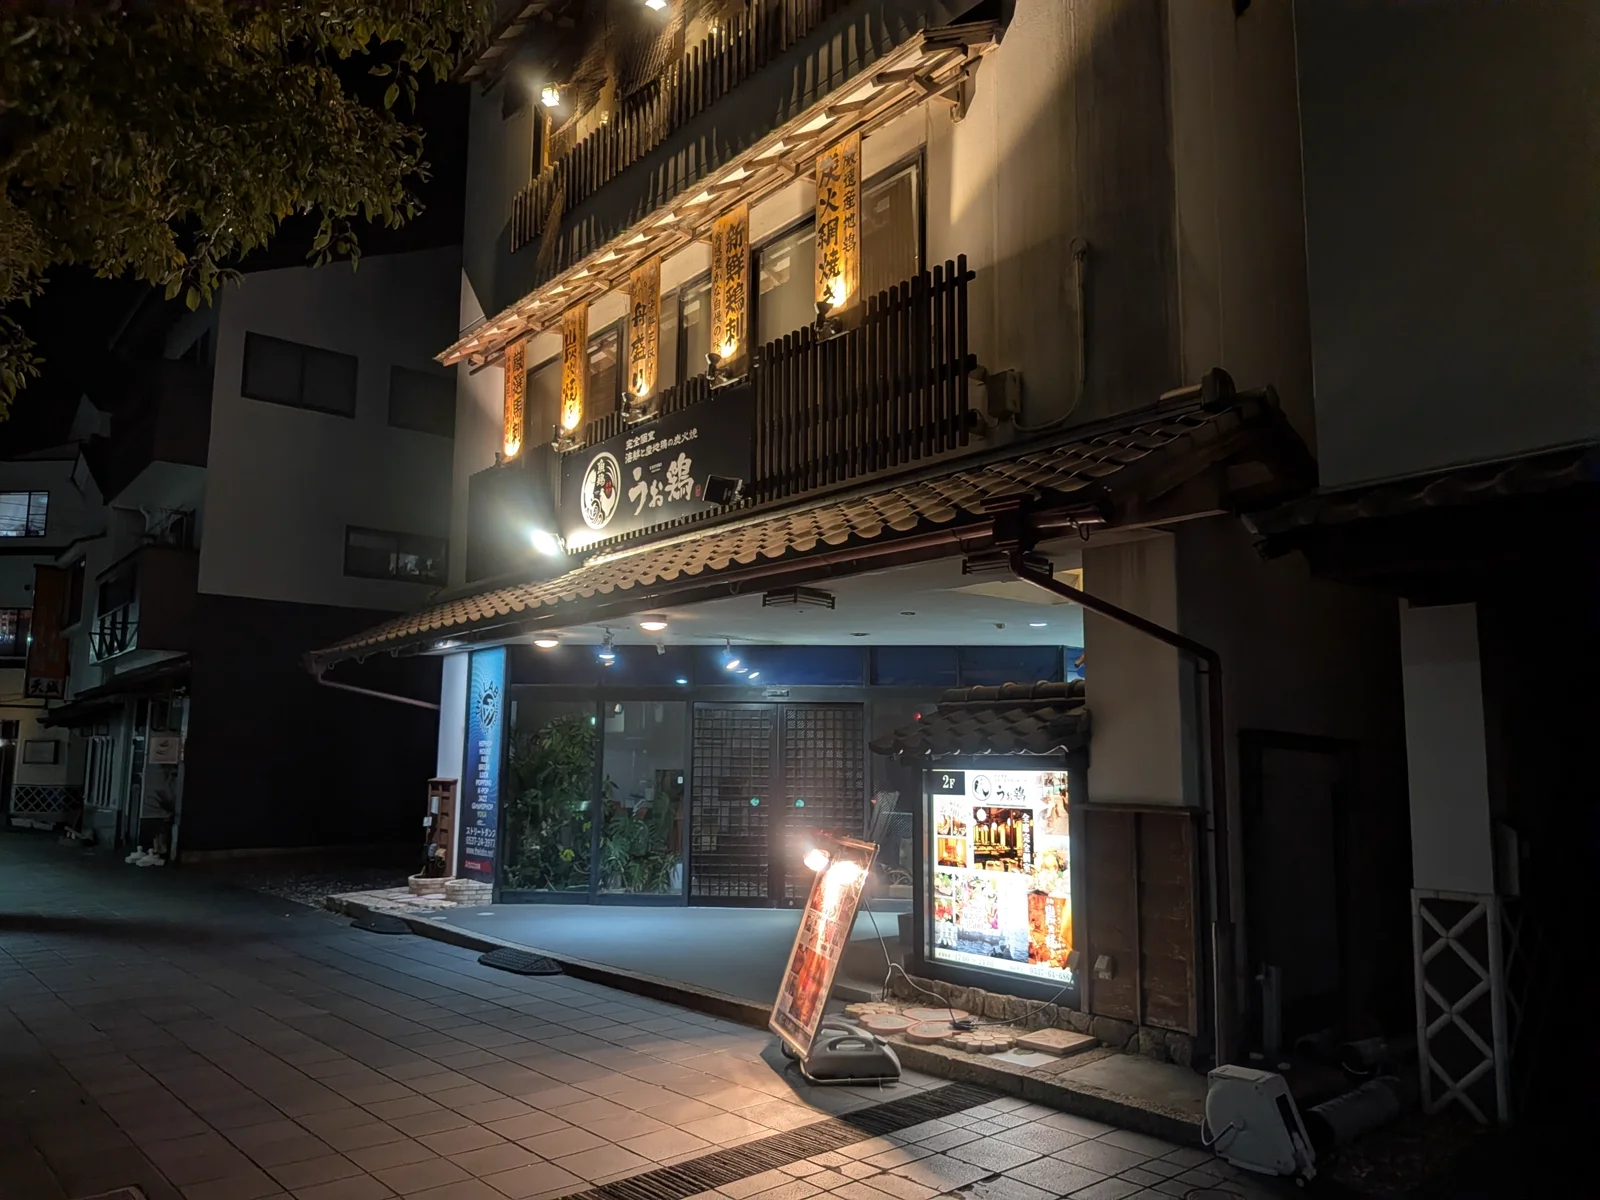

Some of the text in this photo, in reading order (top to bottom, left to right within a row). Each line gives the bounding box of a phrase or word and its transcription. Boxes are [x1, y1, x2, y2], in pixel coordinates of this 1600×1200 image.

[726, 223, 745, 348] 新鮮鶏刺
[626, 430, 656, 450] 完全個室
[628, 452, 695, 516] うお鶏
[942, 774, 956, 789] 2F
